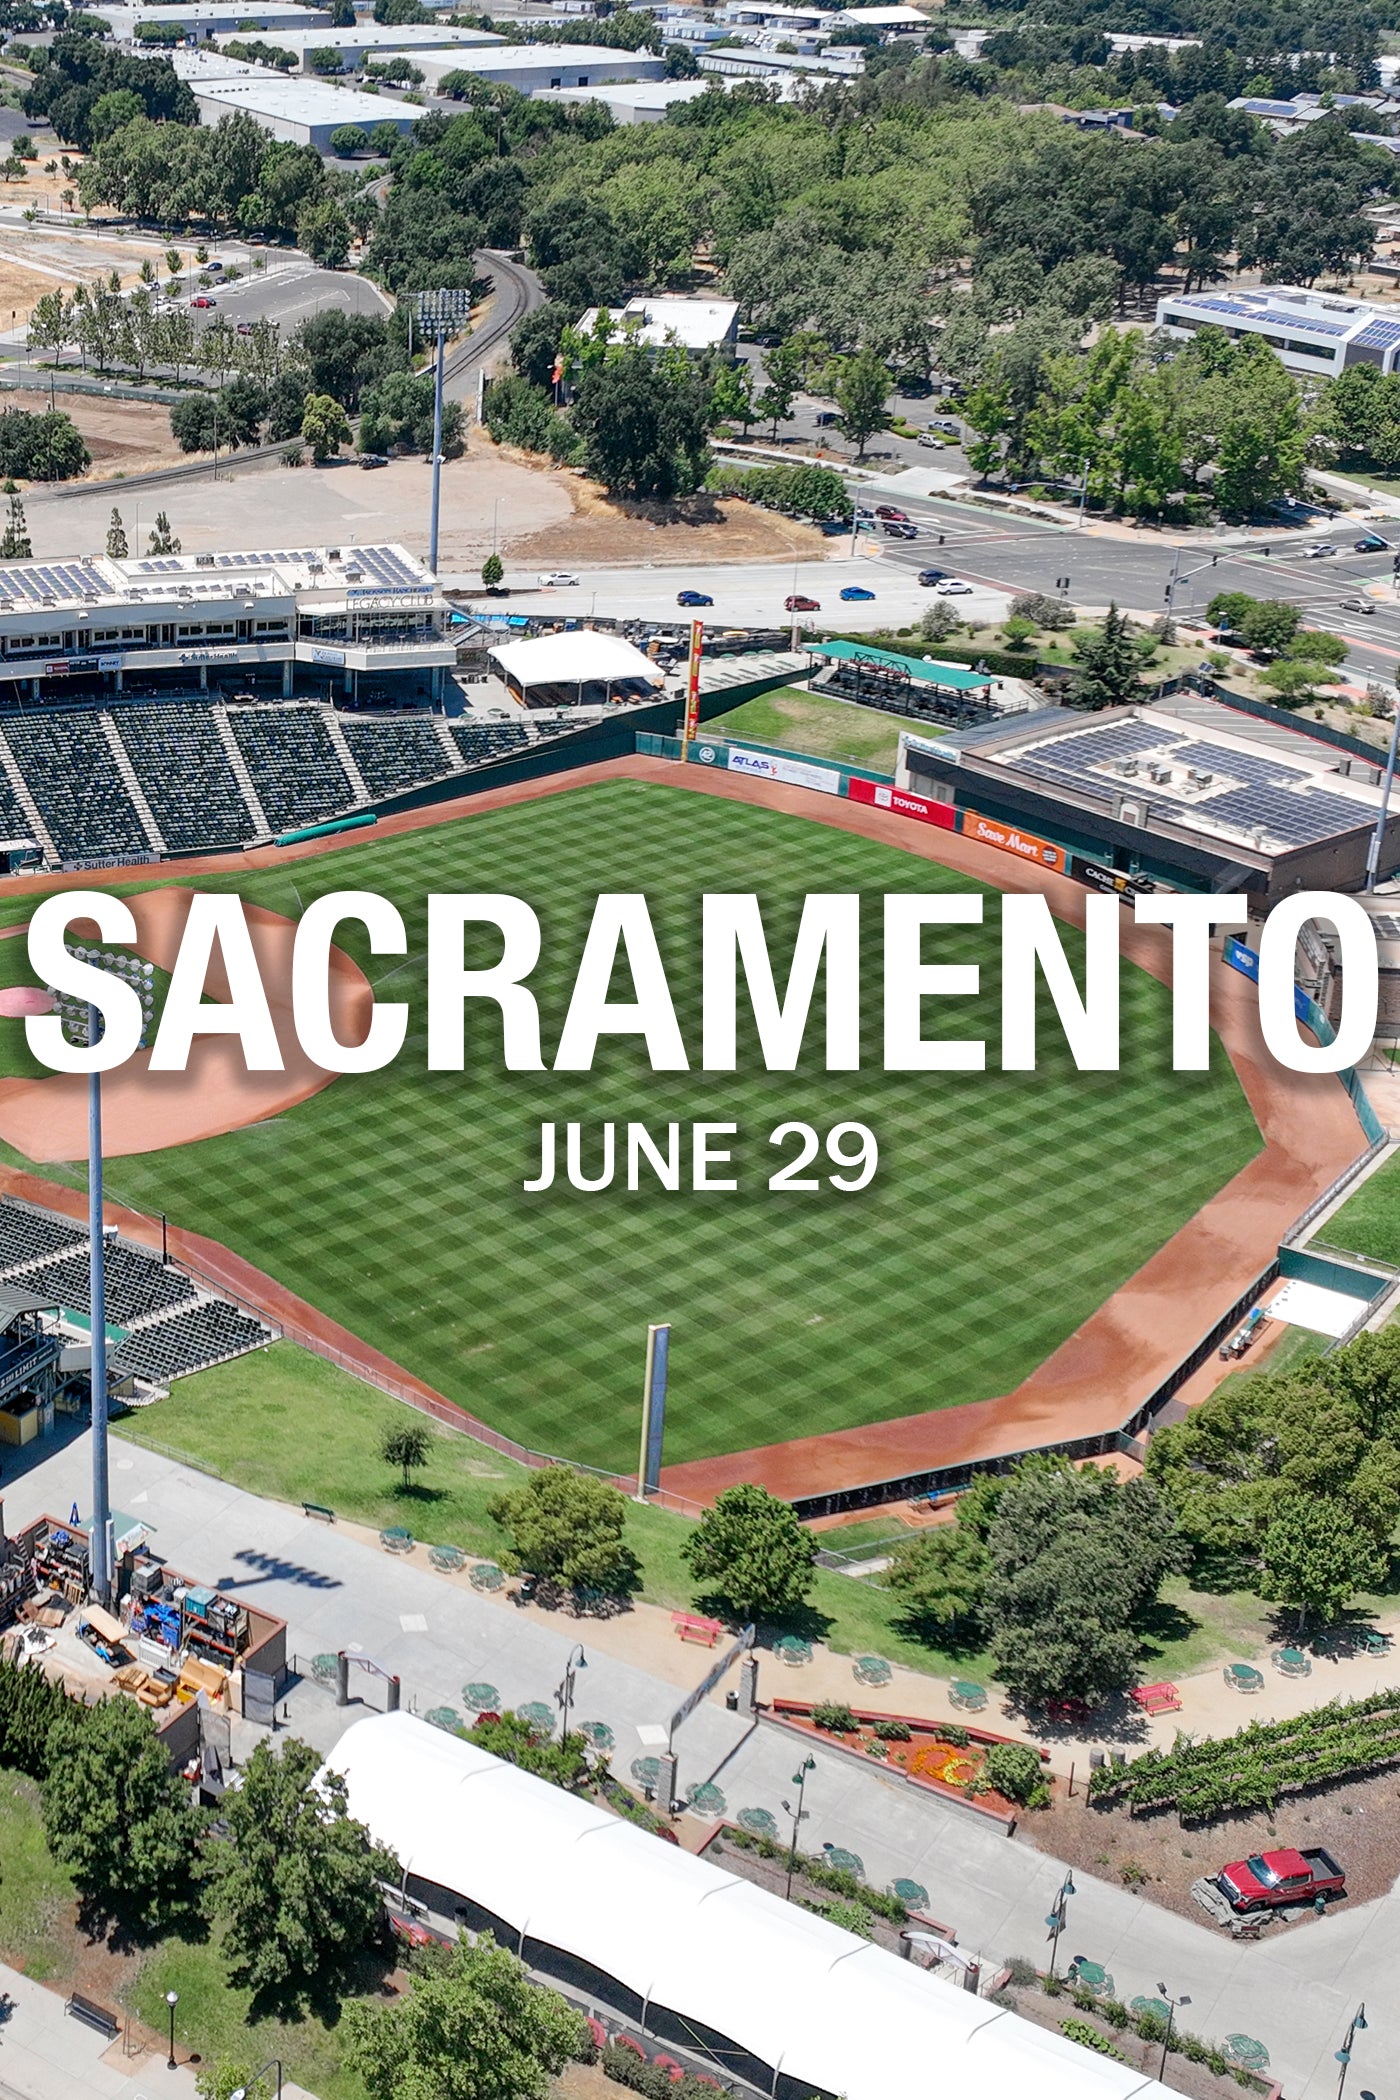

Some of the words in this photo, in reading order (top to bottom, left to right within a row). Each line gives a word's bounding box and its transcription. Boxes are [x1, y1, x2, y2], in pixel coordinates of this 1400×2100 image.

[346, 596, 397, 611] LEGACY
[400, 594, 434, 608] CLUB
[732, 756, 770, 770] ATLAS
[893, 796, 928, 815] TOYOTA
[977, 822, 1005, 844] Save
[1005, 833, 1039, 857] Mart
[84, 859, 116, 870] Sutter
[117, 855, 150, 867] Health
[1085, 867, 1114, 885] CACHE
[15, 1355, 38, 1378] LIMIT
